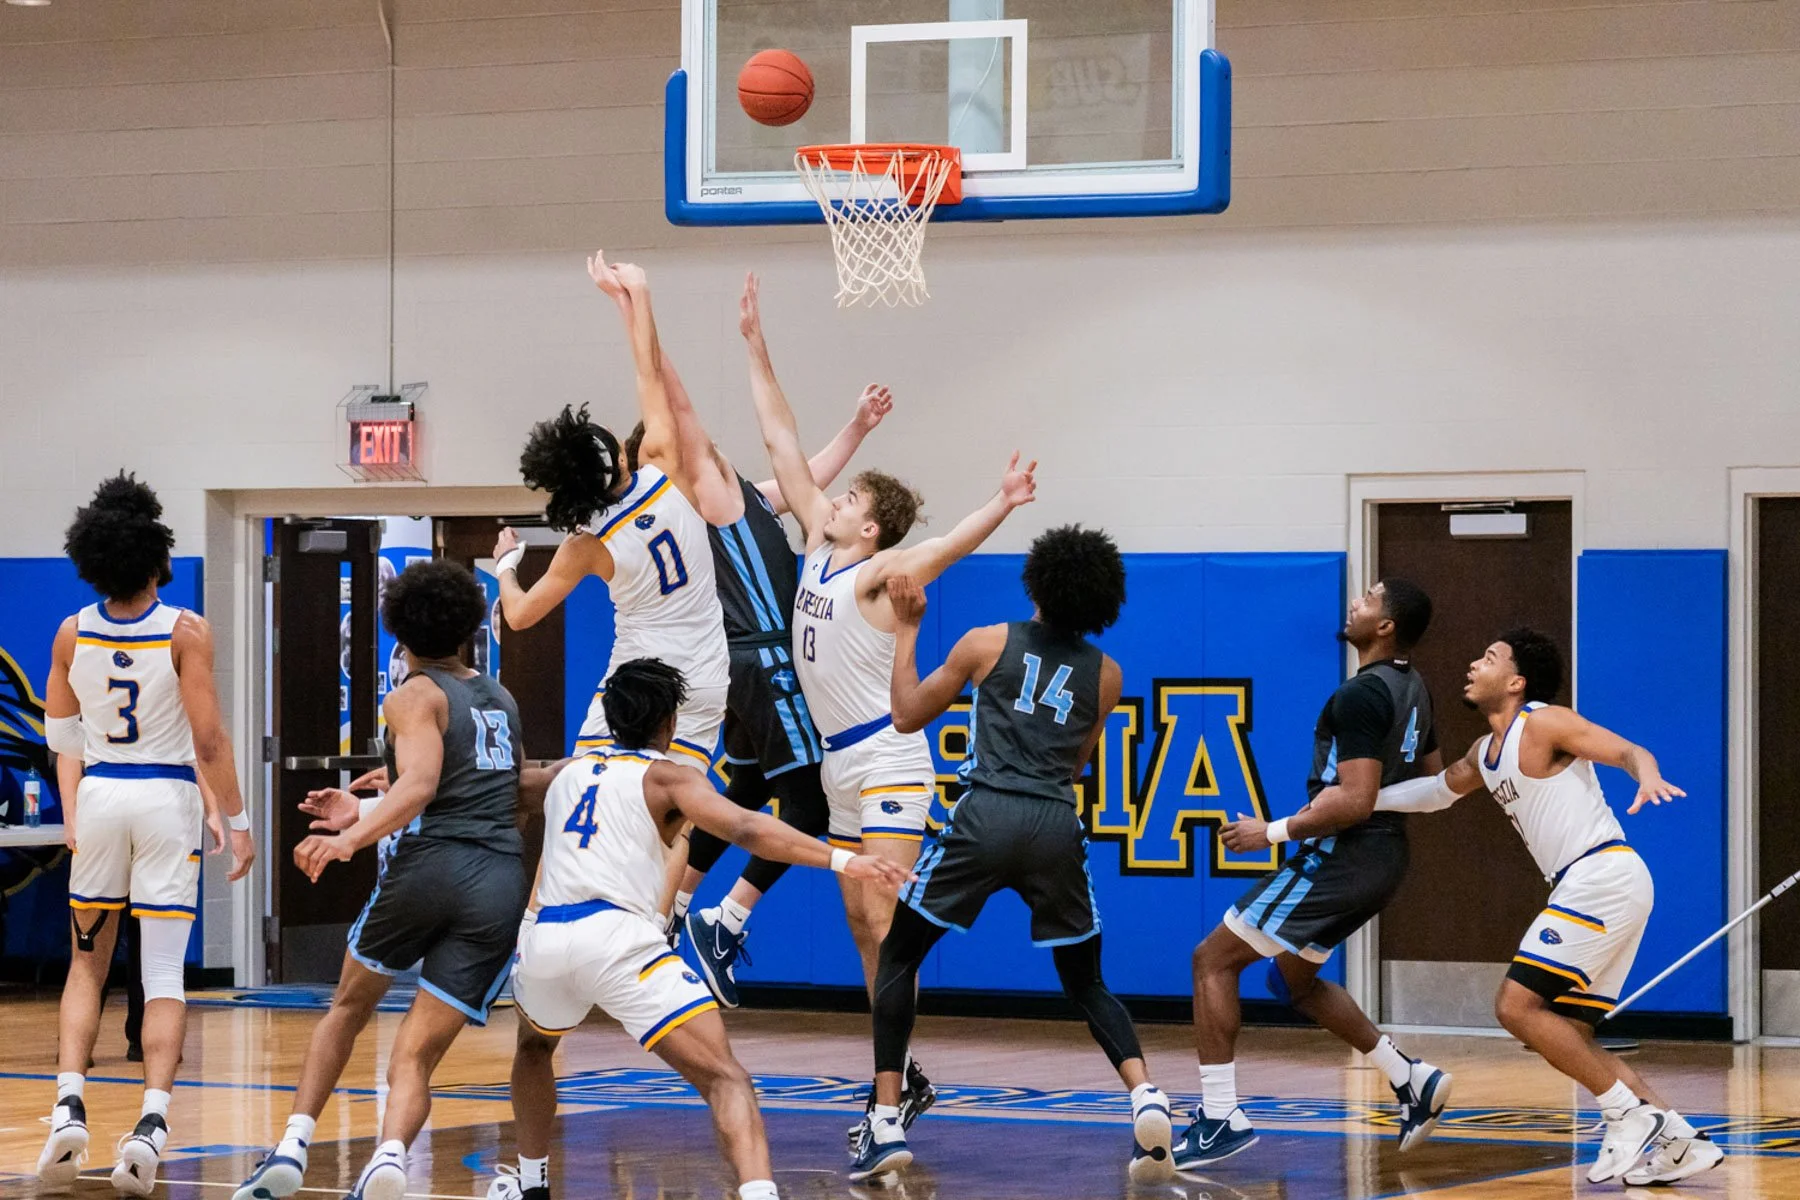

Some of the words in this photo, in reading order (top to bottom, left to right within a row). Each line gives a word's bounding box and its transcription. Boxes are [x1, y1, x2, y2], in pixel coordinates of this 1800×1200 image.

[360, 425, 403, 464] EXIT
[647, 528, 689, 596] 0
[803, 624, 816, 663] 13
[105, 676, 140, 744] 3
[1013, 652, 1074, 725] 14
[470, 707, 515, 771] 13
[563, 783, 600, 849] 4
